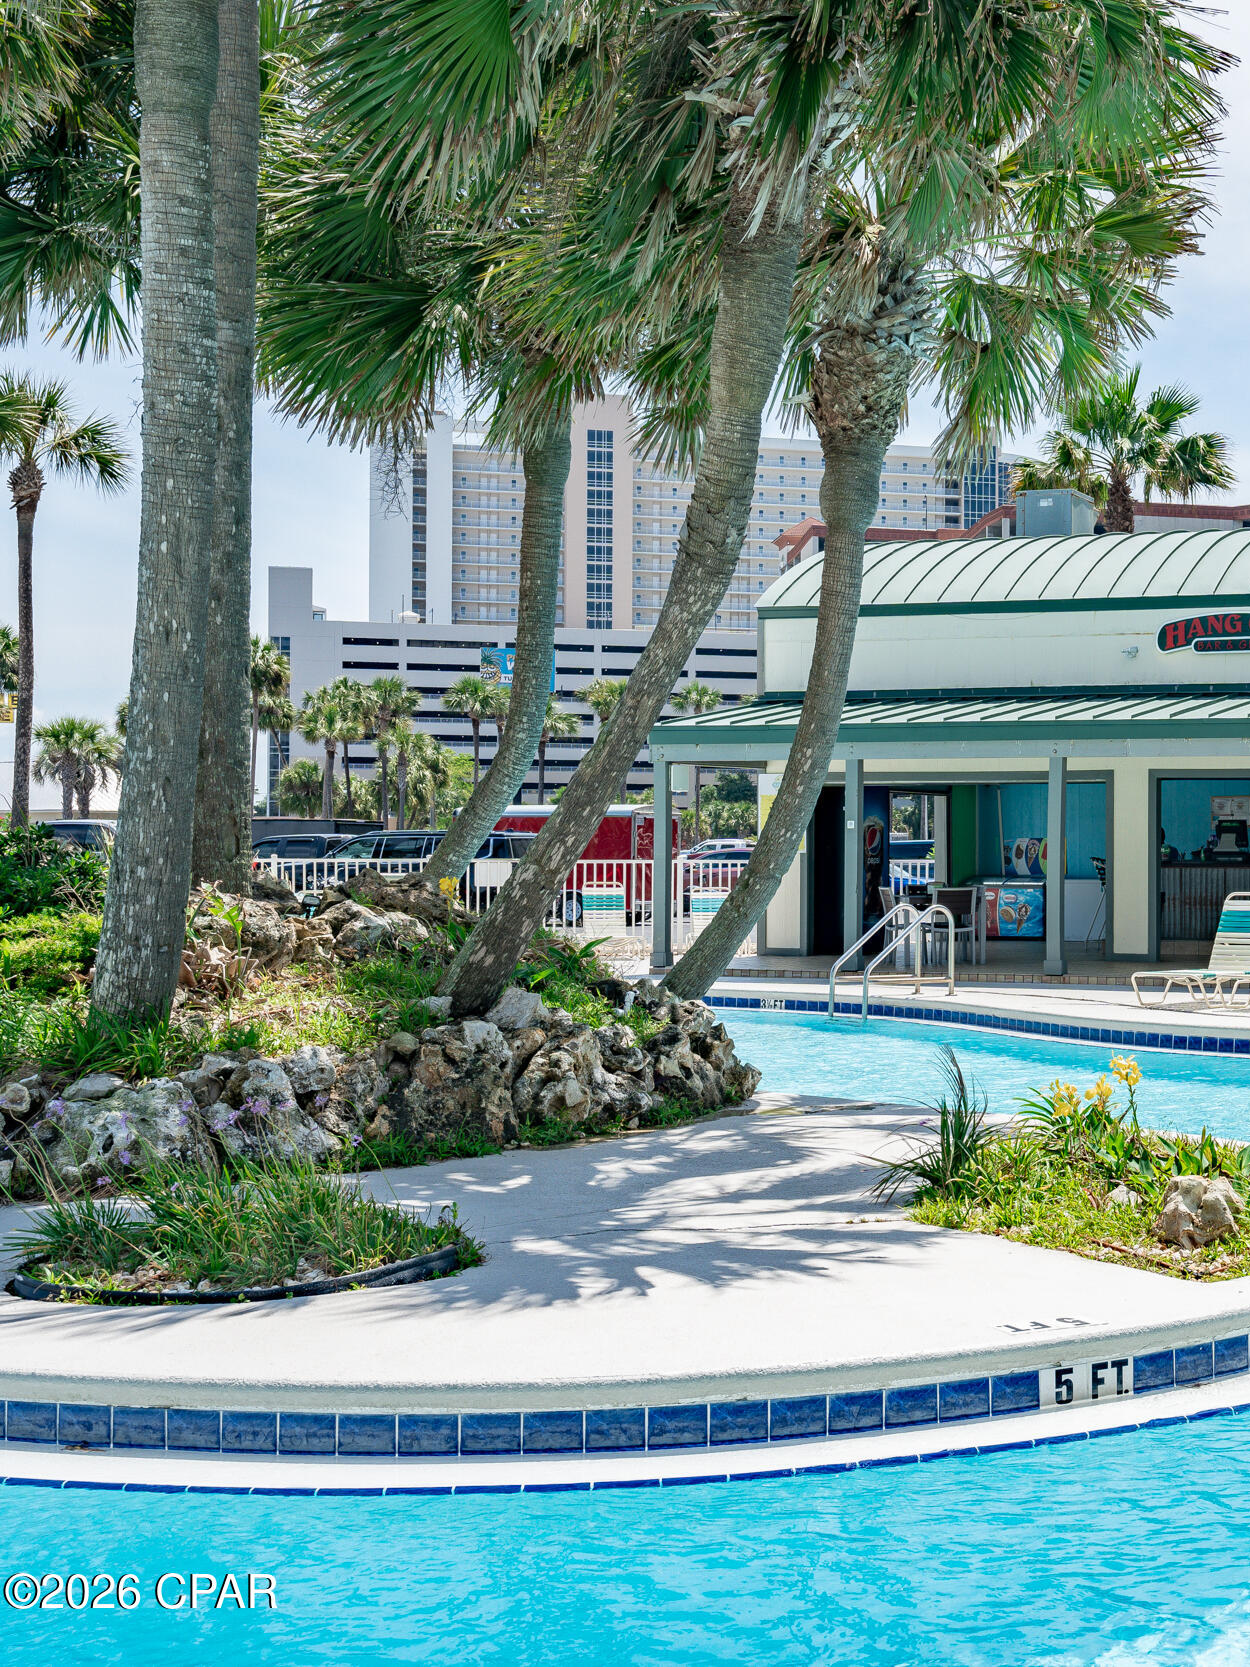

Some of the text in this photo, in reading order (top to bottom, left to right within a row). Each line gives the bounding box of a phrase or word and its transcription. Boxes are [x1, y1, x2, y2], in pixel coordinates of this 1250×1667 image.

[1164, 614, 1243, 650] HANG
[1197, 641, 1222, 651] BAR
[1226, 640, 1234, 650] &
[1055, 1317, 1091, 1326] 5
[1055, 1358, 1130, 1405] 5 FT.
